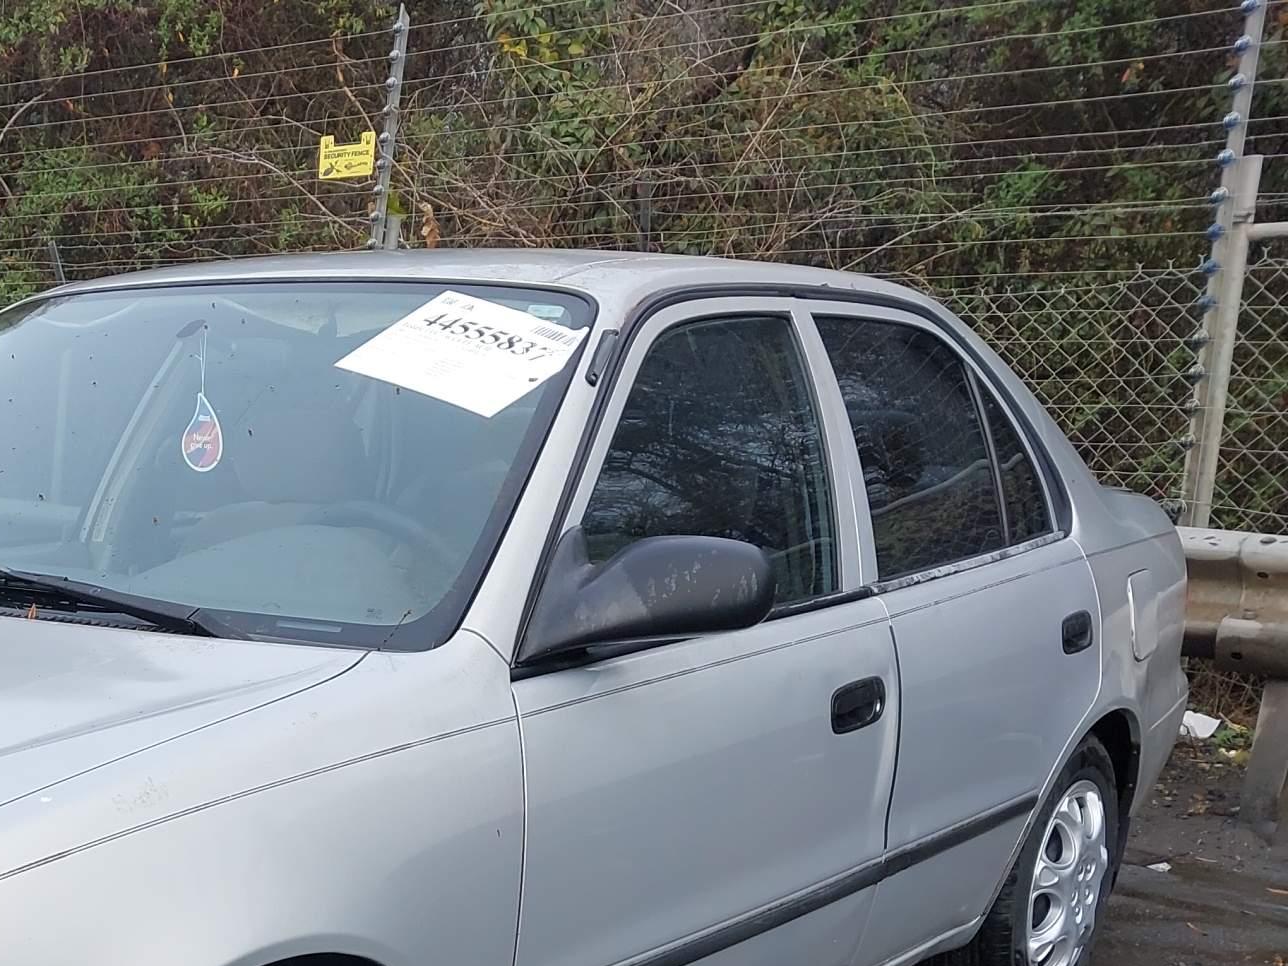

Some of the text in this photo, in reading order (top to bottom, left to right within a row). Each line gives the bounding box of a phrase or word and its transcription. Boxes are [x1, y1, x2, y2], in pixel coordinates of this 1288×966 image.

[323, 151, 351, 160] SECURITY
[351, 149, 370, 158] FENCE
[423, 313, 552, 361] 44555837
